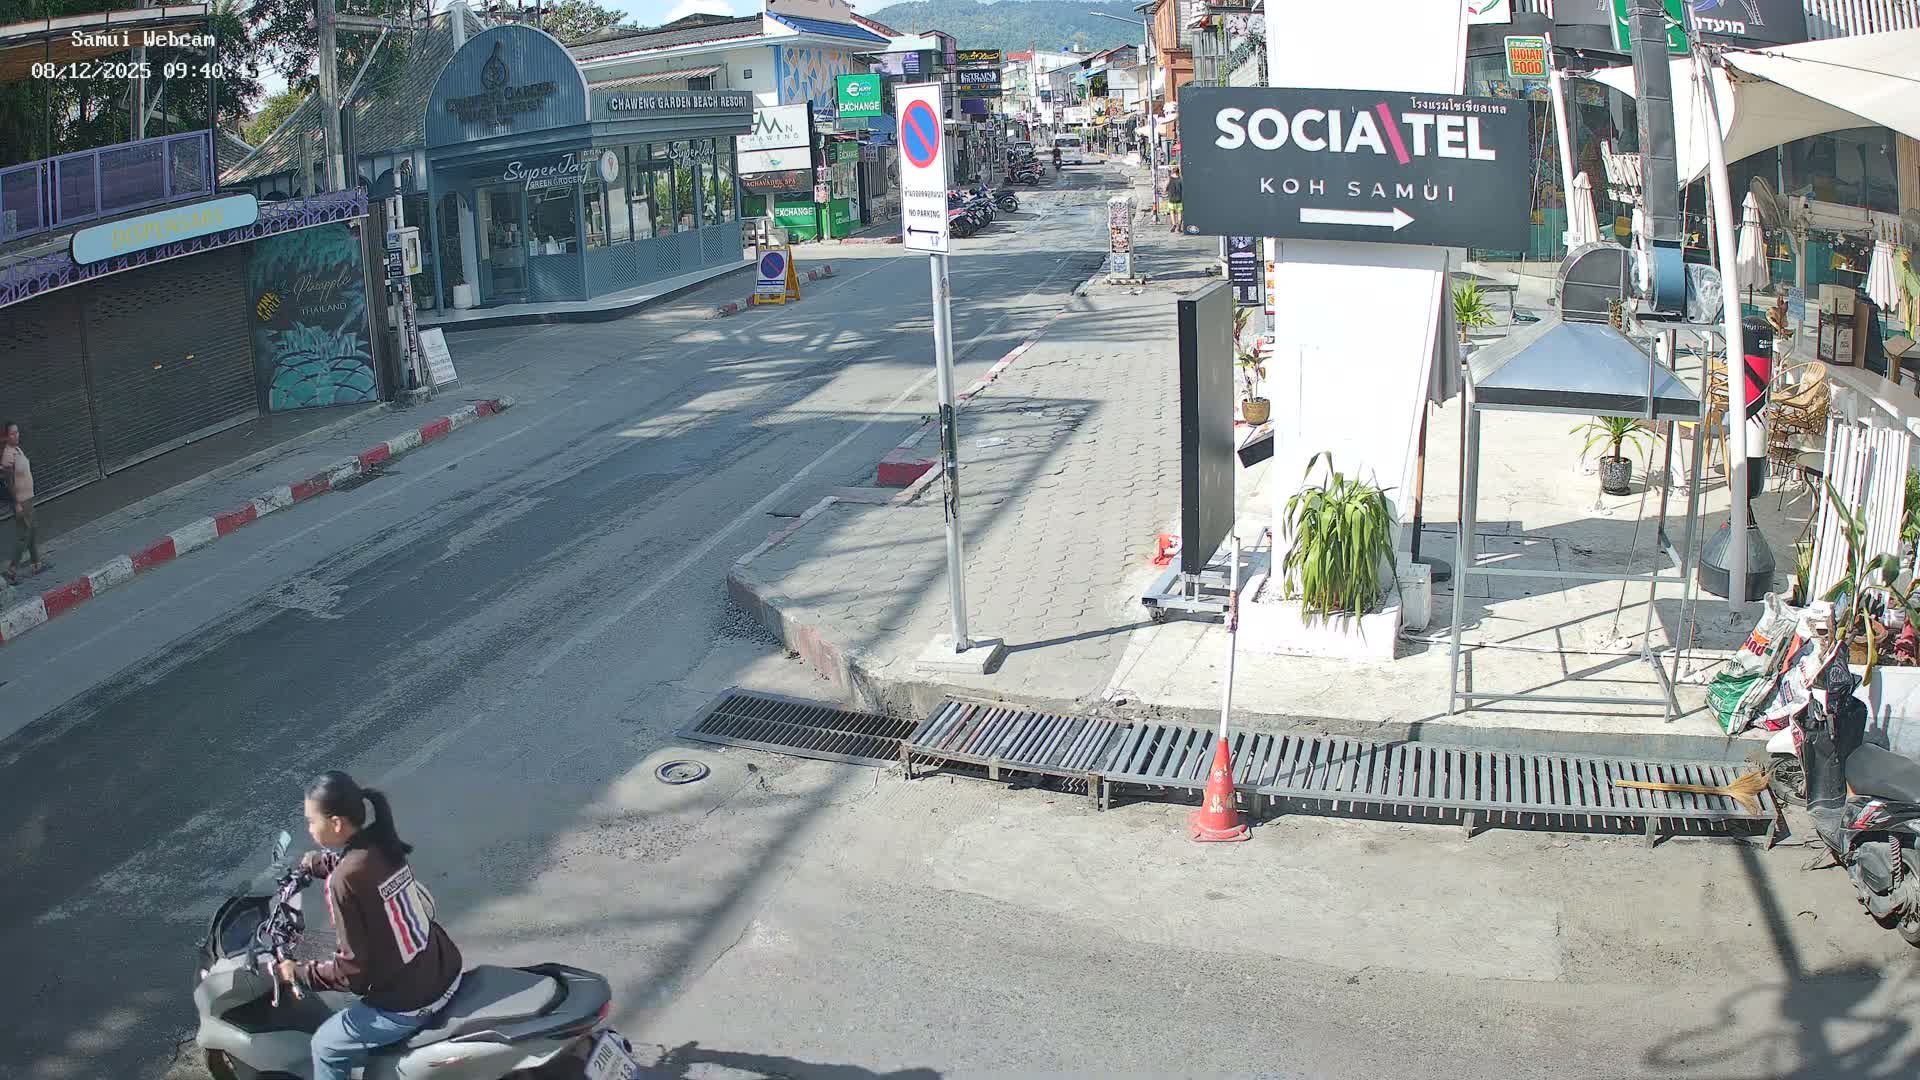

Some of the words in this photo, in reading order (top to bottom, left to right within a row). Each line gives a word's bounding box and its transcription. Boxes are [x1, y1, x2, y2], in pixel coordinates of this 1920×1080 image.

[1510, 47, 1543, 60] INDIAN
[1513, 61, 1542, 74] FOOD
[964, 72, 992, 80] STRAIN
[611, 97, 656, 111] CHAWENG
[657, 96, 691, 109] GARDEN
[693, 95, 718, 108] BEACH
[720, 94, 748, 107] RESORT
[839, 101, 880, 112] EXCHANGE
[741, 131, 799, 144] CHAWENG
[1260, 177, 1325, 195] KOH
[1347, 181, 1453, 201] SAMUI
[775, 207, 814, 217] EXCHANGE
[908, 208, 917, 217] NO
[917, 209, 941, 219] PARKING
[112, 206, 225, 252] DISPENSARY
[302, 302, 347, 316] THAILAND
